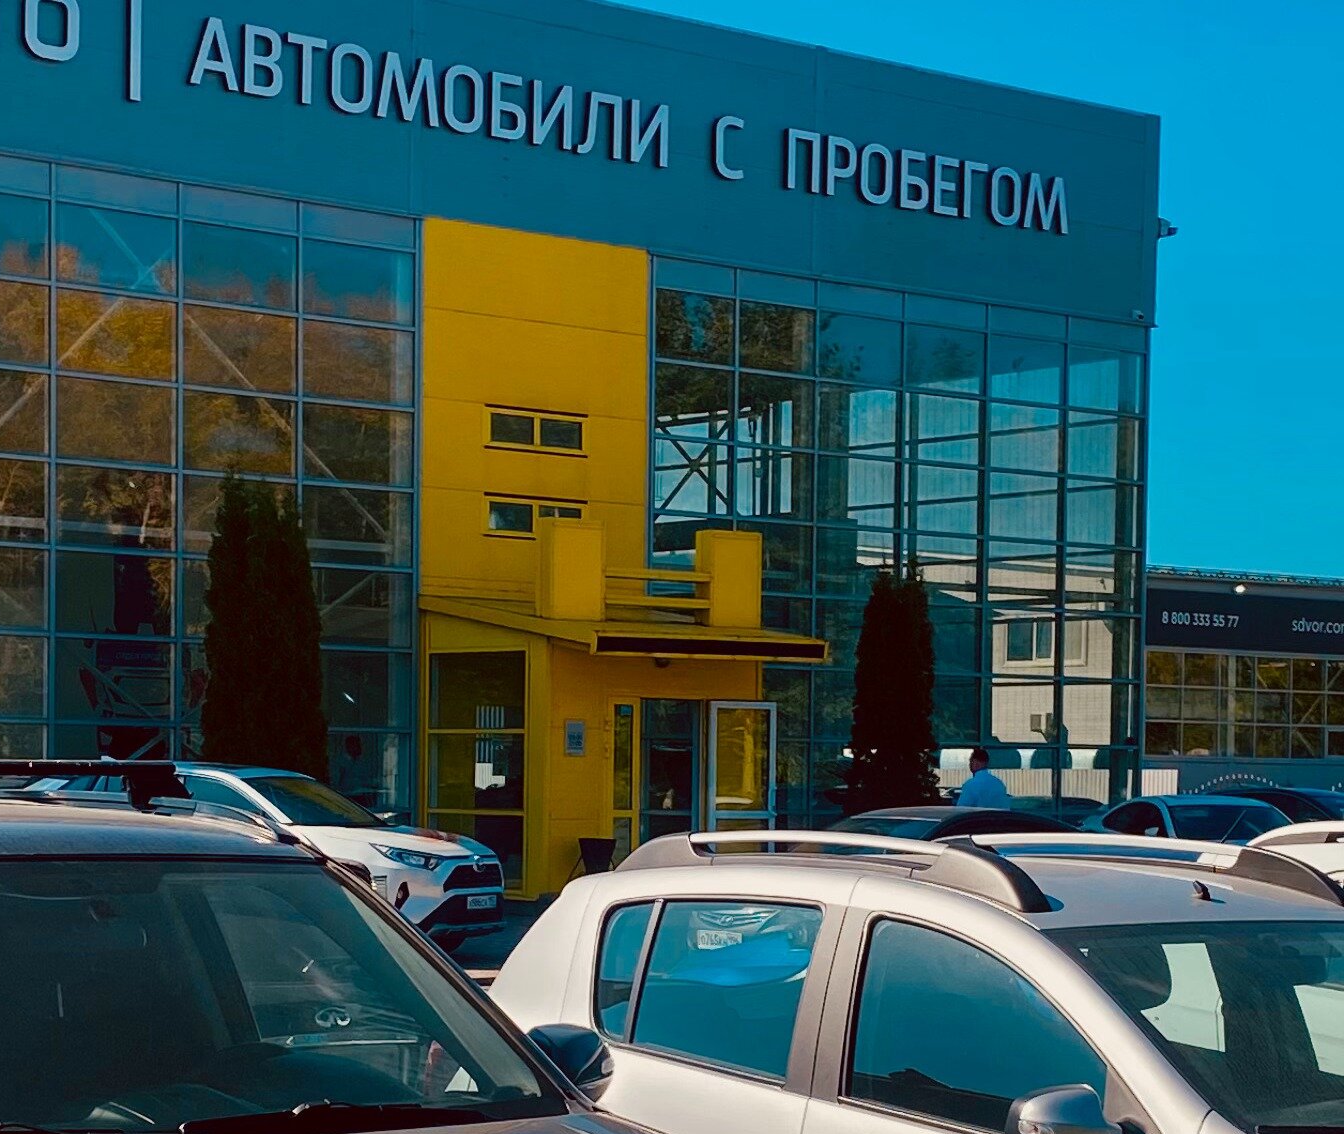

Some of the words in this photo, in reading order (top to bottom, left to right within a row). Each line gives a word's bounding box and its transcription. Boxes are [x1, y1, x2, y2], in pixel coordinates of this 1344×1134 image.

[189, 17, 669, 168] АВТОМОБИЛИ
[713, 116, 744, 180] С
[786, 129, 1069, 235] ПРОБЕГОМ
[1161, 611, 1168, 624] 8
[1171, 612, 1191, 625] 800
[1193, 613, 1210, 627] 333
[1212, 614, 1225, 627] 55
[1227, 615, 1240, 628] 77
